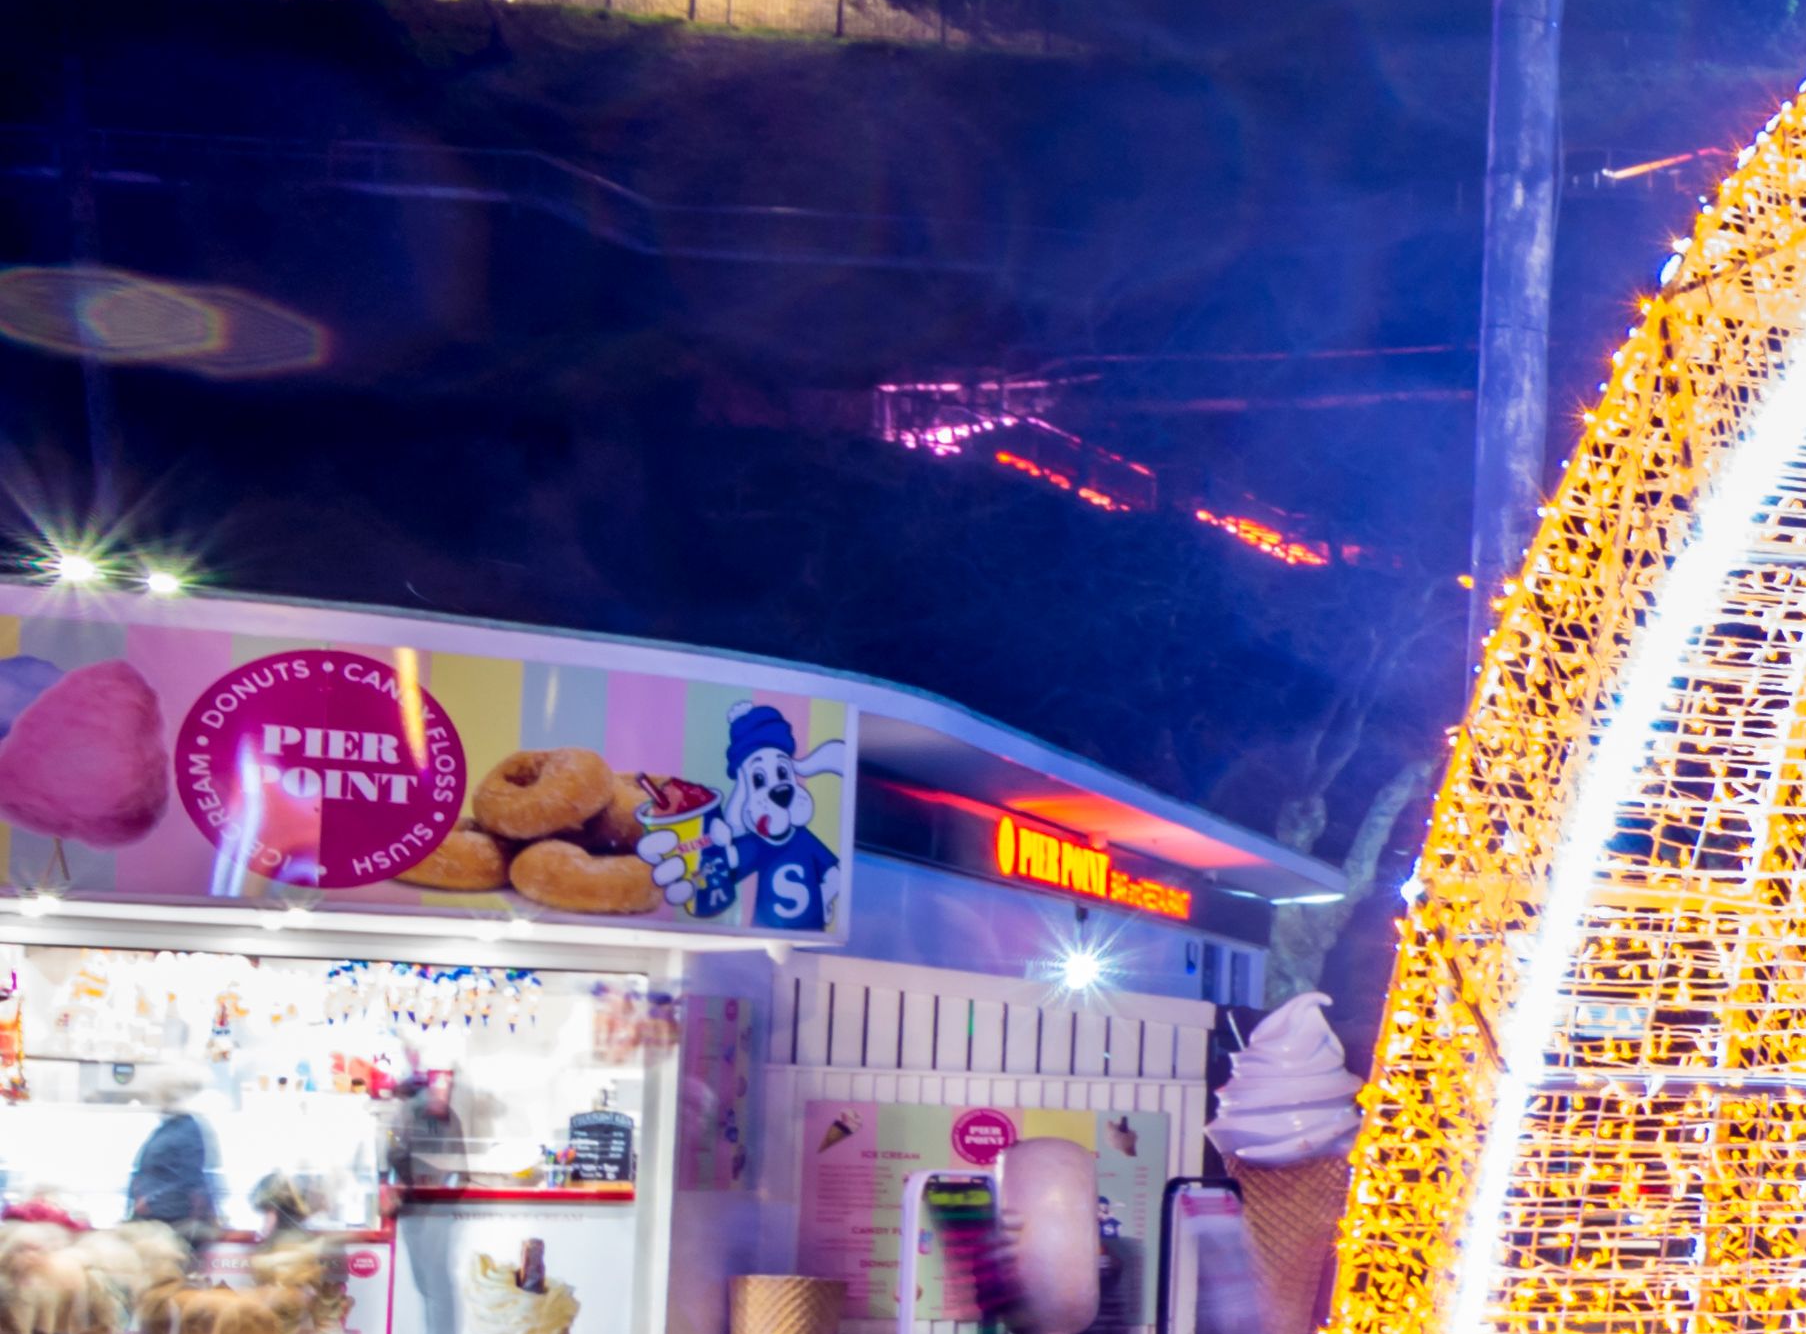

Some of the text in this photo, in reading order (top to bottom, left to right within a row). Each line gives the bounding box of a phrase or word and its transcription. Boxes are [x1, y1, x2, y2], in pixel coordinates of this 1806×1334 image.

[200, 659, 311, 730] DONUTS
[261, 723, 402, 765] PIER
[343, 662, 458, 805] CANY FLOSS
[350, 821, 435, 877] SLUSH
[1018, 827, 1060, 883] PIER
[1061, 841, 1109, 897] POINT
[771, 863, 811, 919] S
[964, 1134, 1005, 1145] POINT
[968, 1125, 1002, 1135] PIER
